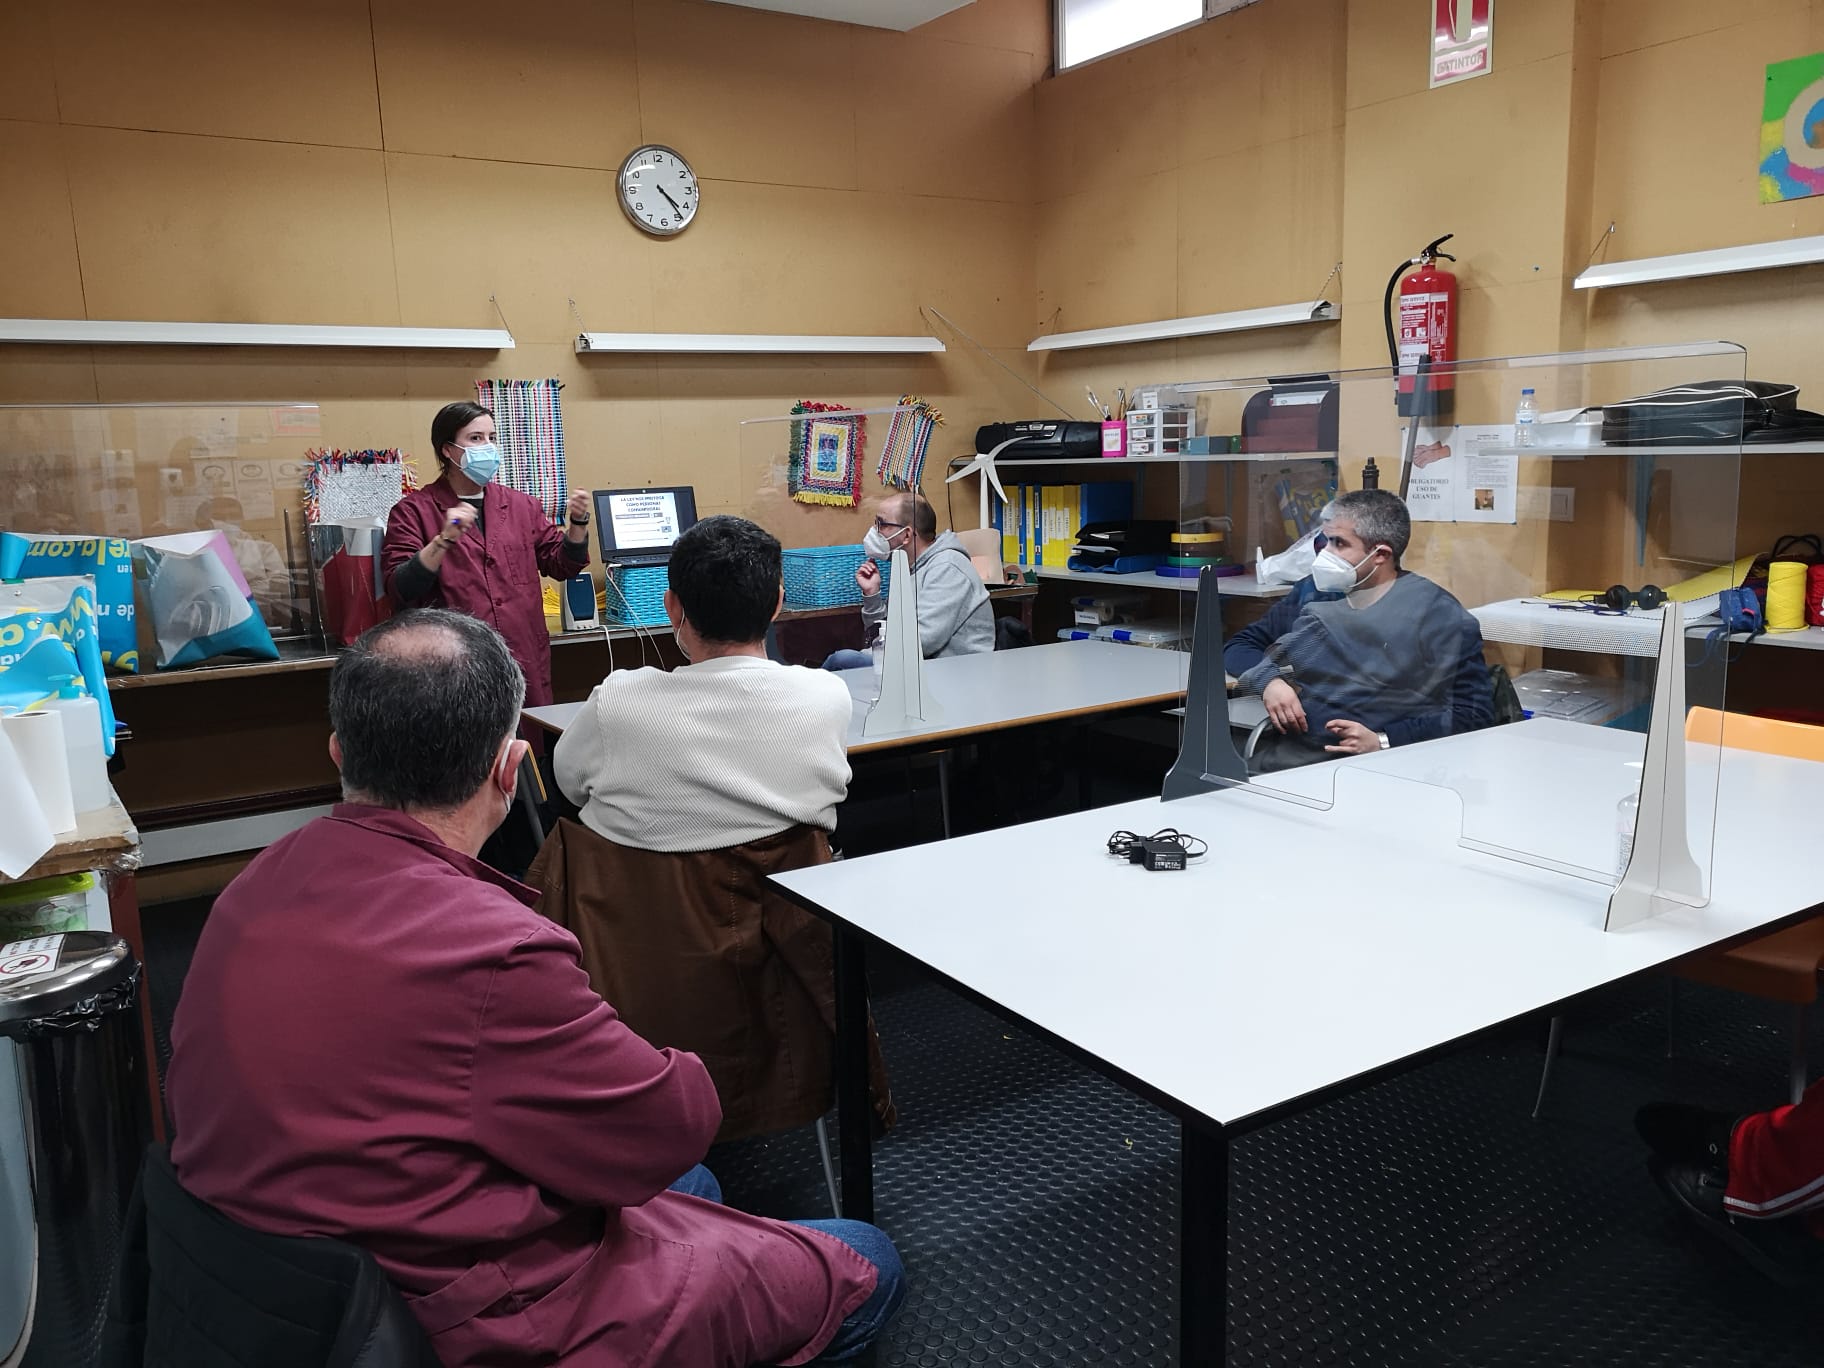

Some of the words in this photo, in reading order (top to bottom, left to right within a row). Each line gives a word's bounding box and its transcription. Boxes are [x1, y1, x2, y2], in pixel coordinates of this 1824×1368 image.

[653, 154, 663, 163] 12
[632, 170, 641, 179] 10
[679, 170, 686, 179] 2
[628, 186, 637, 195] 9
[684, 186, 692, 195] 3
[635, 202, 644, 211] 8
[683, 201, 690, 210] 4
[647, 214, 653, 222] 7
[660, 218, 669, 227] 6
[116, 604, 135, 621] de
